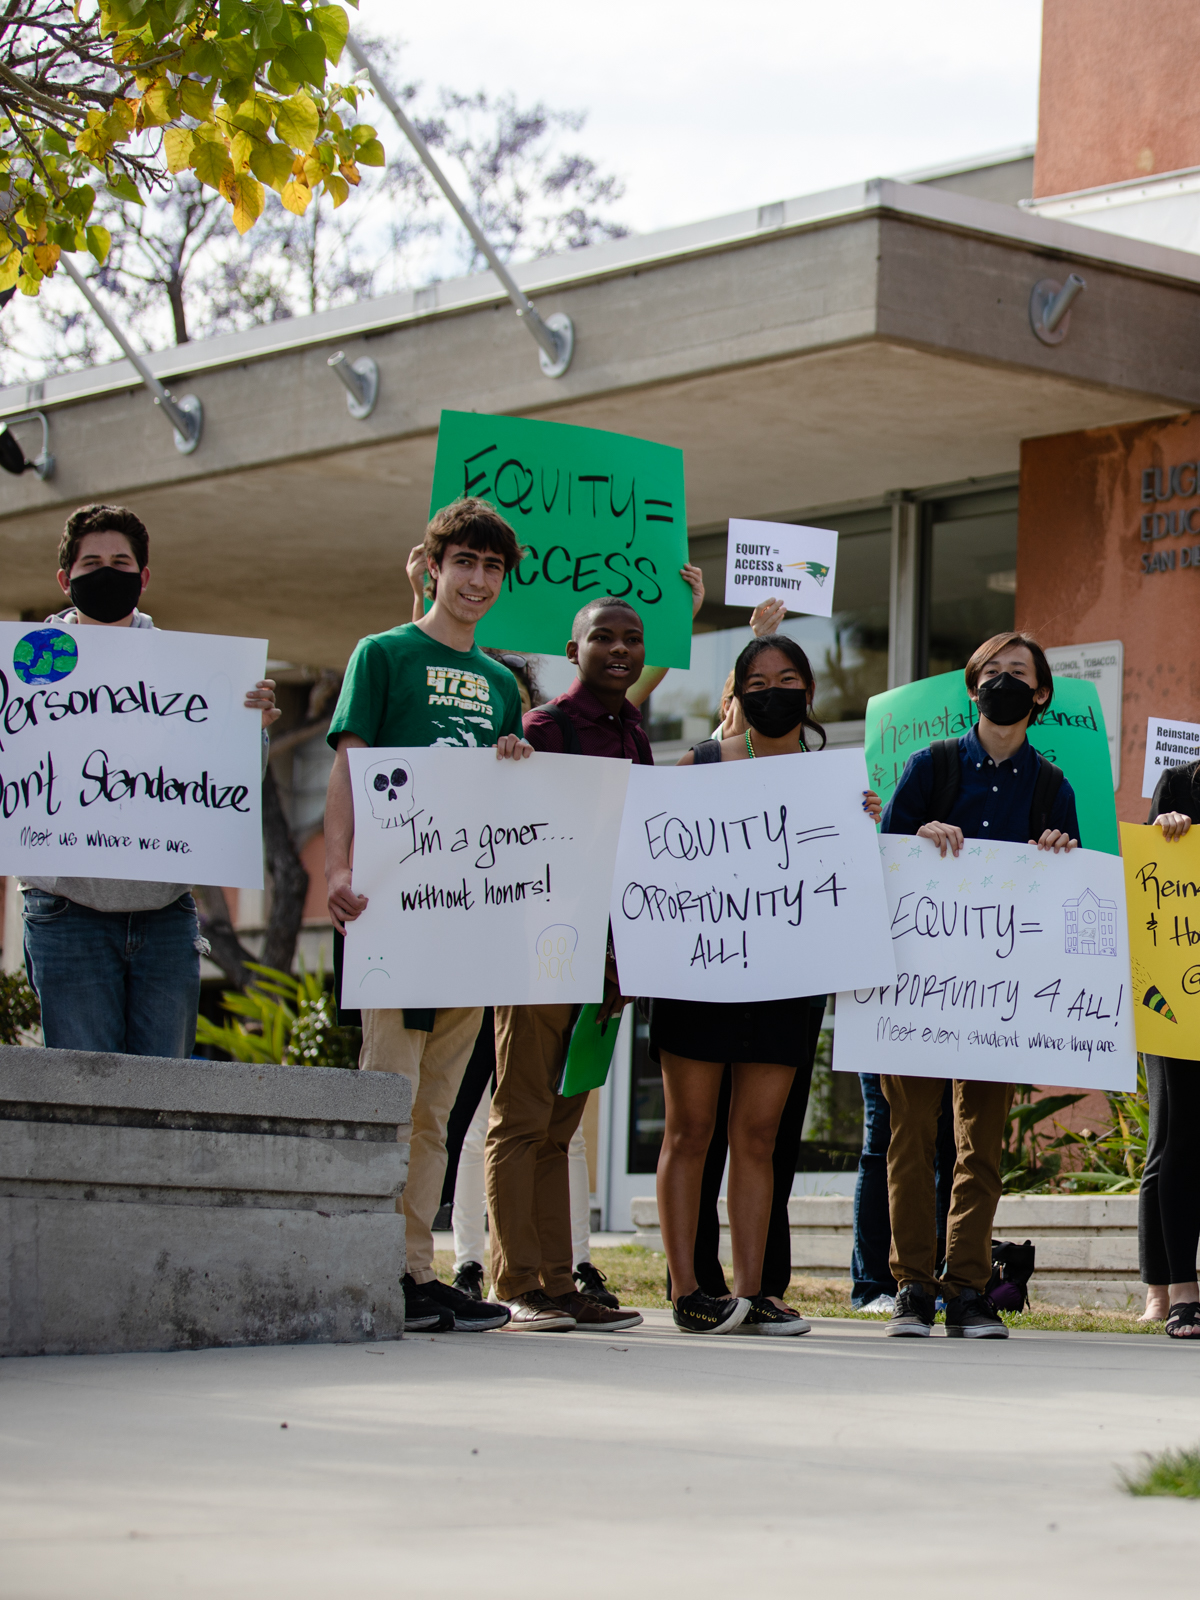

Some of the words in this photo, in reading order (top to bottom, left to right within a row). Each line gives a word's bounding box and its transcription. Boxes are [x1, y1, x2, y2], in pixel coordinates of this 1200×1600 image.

[735, 558, 774, 572] ACCESS
[776, 563, 783, 573] &
[736, 543, 771, 556] EQUITY
[1141, 549, 1175, 574] SAN
[734, 574, 802, 591] OPPORTUNITY
[876, 700, 977, 754] Reinstat
[1157, 726, 1200, 742] Reinstate
[1154, 756, 1161, 765] &
[1155, 741, 1200, 756] Advanced
[0, 750, 62, 819] on't
[79, 749, 250, 813] Standardize
[20, 826, 52, 849] Meet
[59, 832, 78, 846] us
[86, 830, 132, 848] where
[139, 836, 160, 850] we
[400, 809, 441, 864] I'm
[451, 828, 468, 852] a
[401, 878, 475, 911] without
[484, 863, 551, 902] honors!
[622, 880, 804, 926] OPPORTUNITY
[813, 872, 847, 906] 4
[690, 930, 748, 969] ALL!
[1034, 979, 1062, 1012] 4
[1067, 984, 1123, 1027] ALL!
[877, 1016, 917, 1042] Meet
[921, 1027, 960, 1051] every
[967, 1029, 1020, 1049] student
[1028, 1033, 1066, 1051] where
[1067, 1035, 1094, 1062] they
